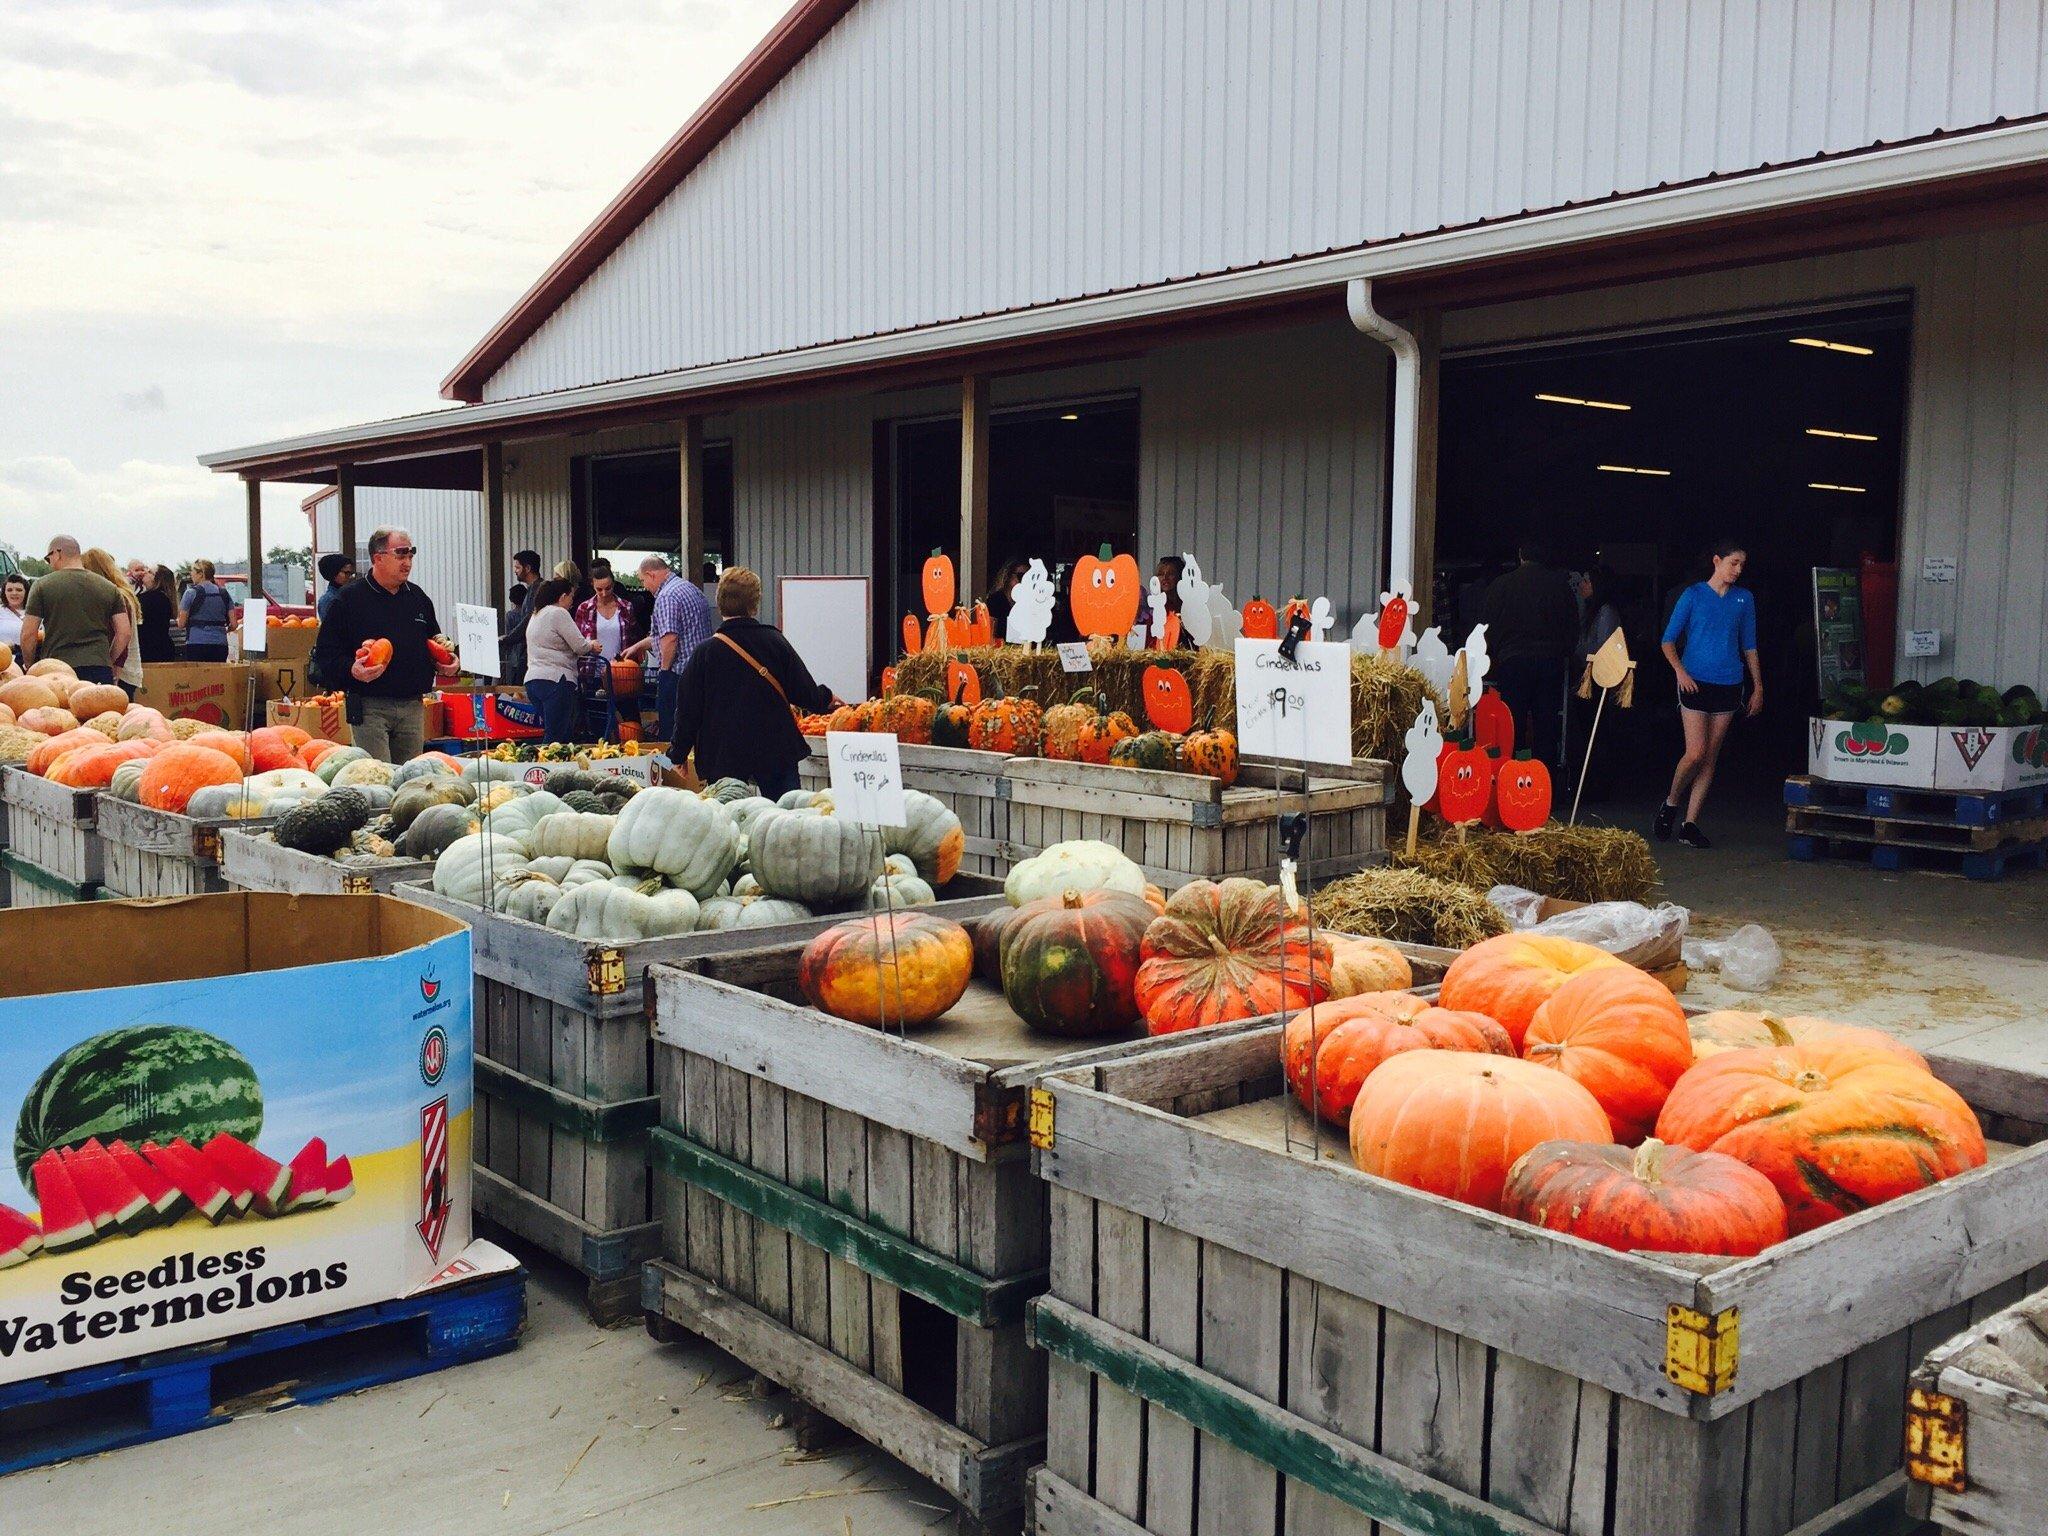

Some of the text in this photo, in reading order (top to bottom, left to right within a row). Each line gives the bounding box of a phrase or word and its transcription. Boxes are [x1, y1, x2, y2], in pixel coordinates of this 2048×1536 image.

[1256, 653, 1322, 672] Cinderellas
[841, 744, 888, 762] Cinderellas
[412, 998, 451, 1020] watermelon.org
[60, 1246, 266, 1305] Seedless
